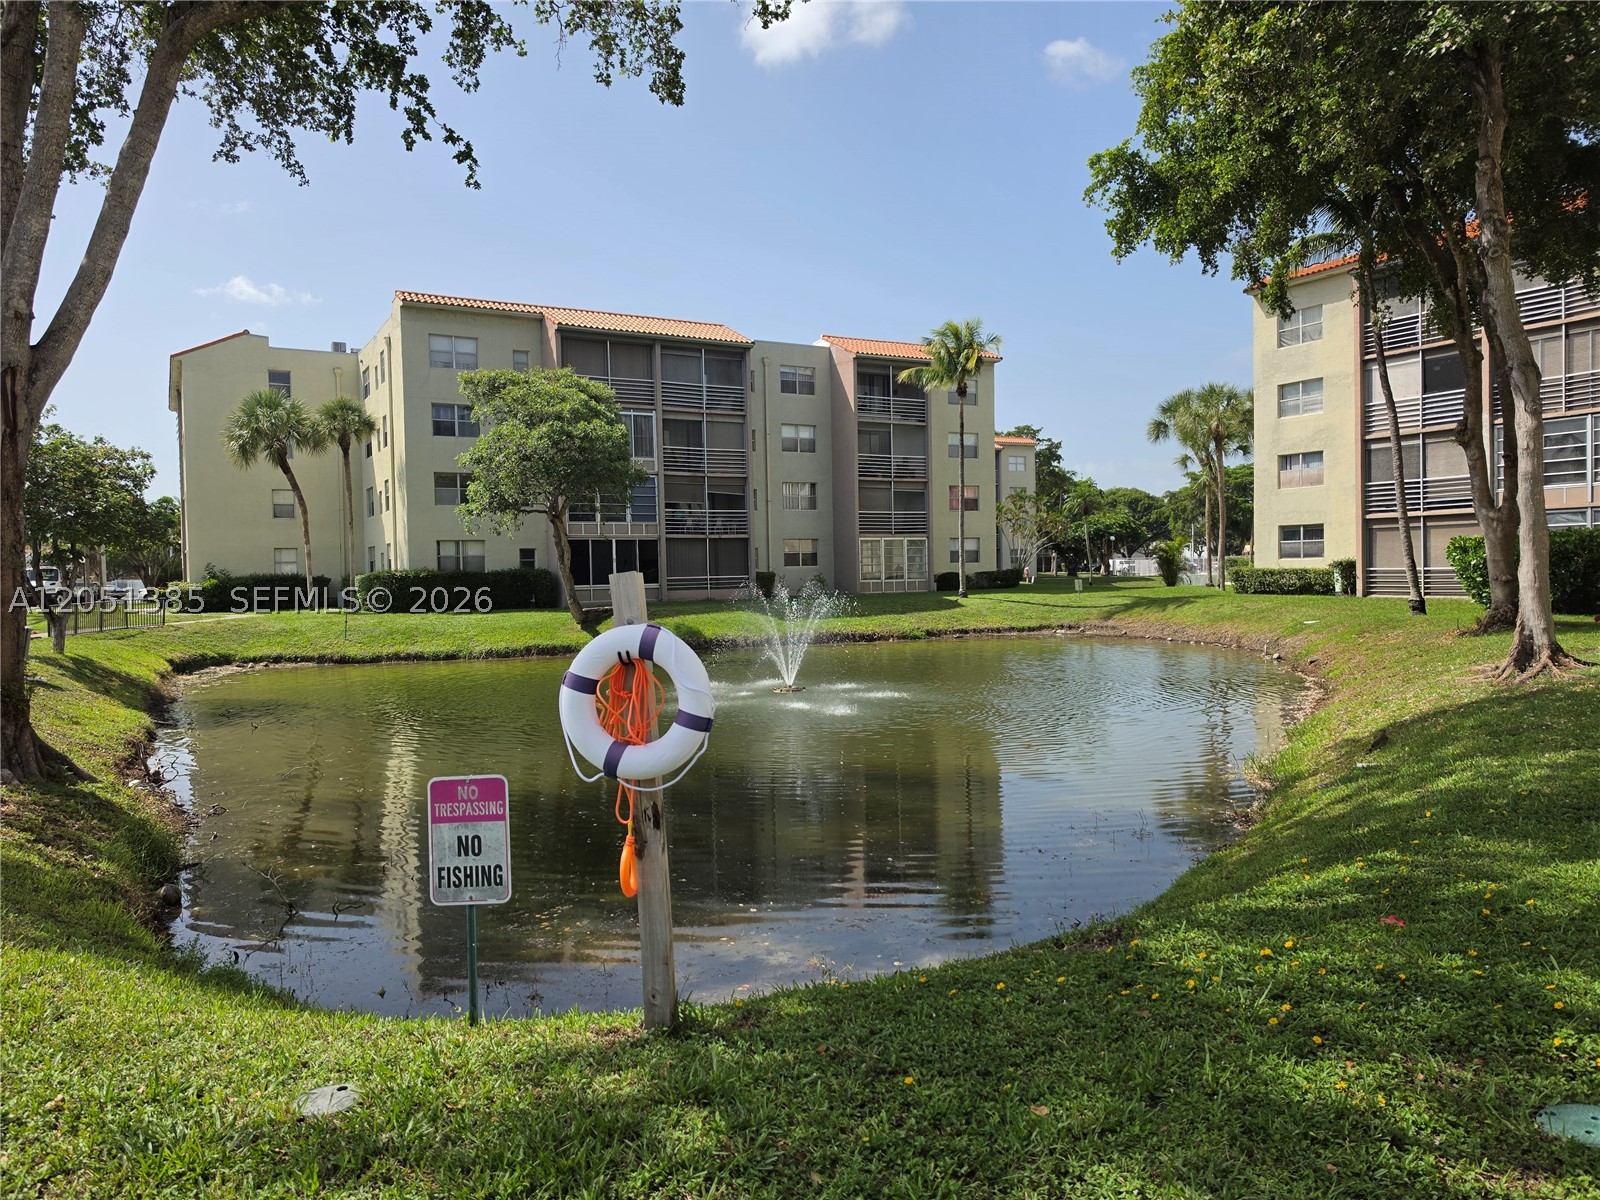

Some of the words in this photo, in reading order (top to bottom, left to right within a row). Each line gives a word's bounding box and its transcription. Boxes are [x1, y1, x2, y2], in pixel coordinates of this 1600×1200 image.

[457, 785, 479, 800] NO
[434, 800, 504, 817] TRESPASSING
[457, 834, 482, 857] NO
[437, 863, 504, 889] FISHING
